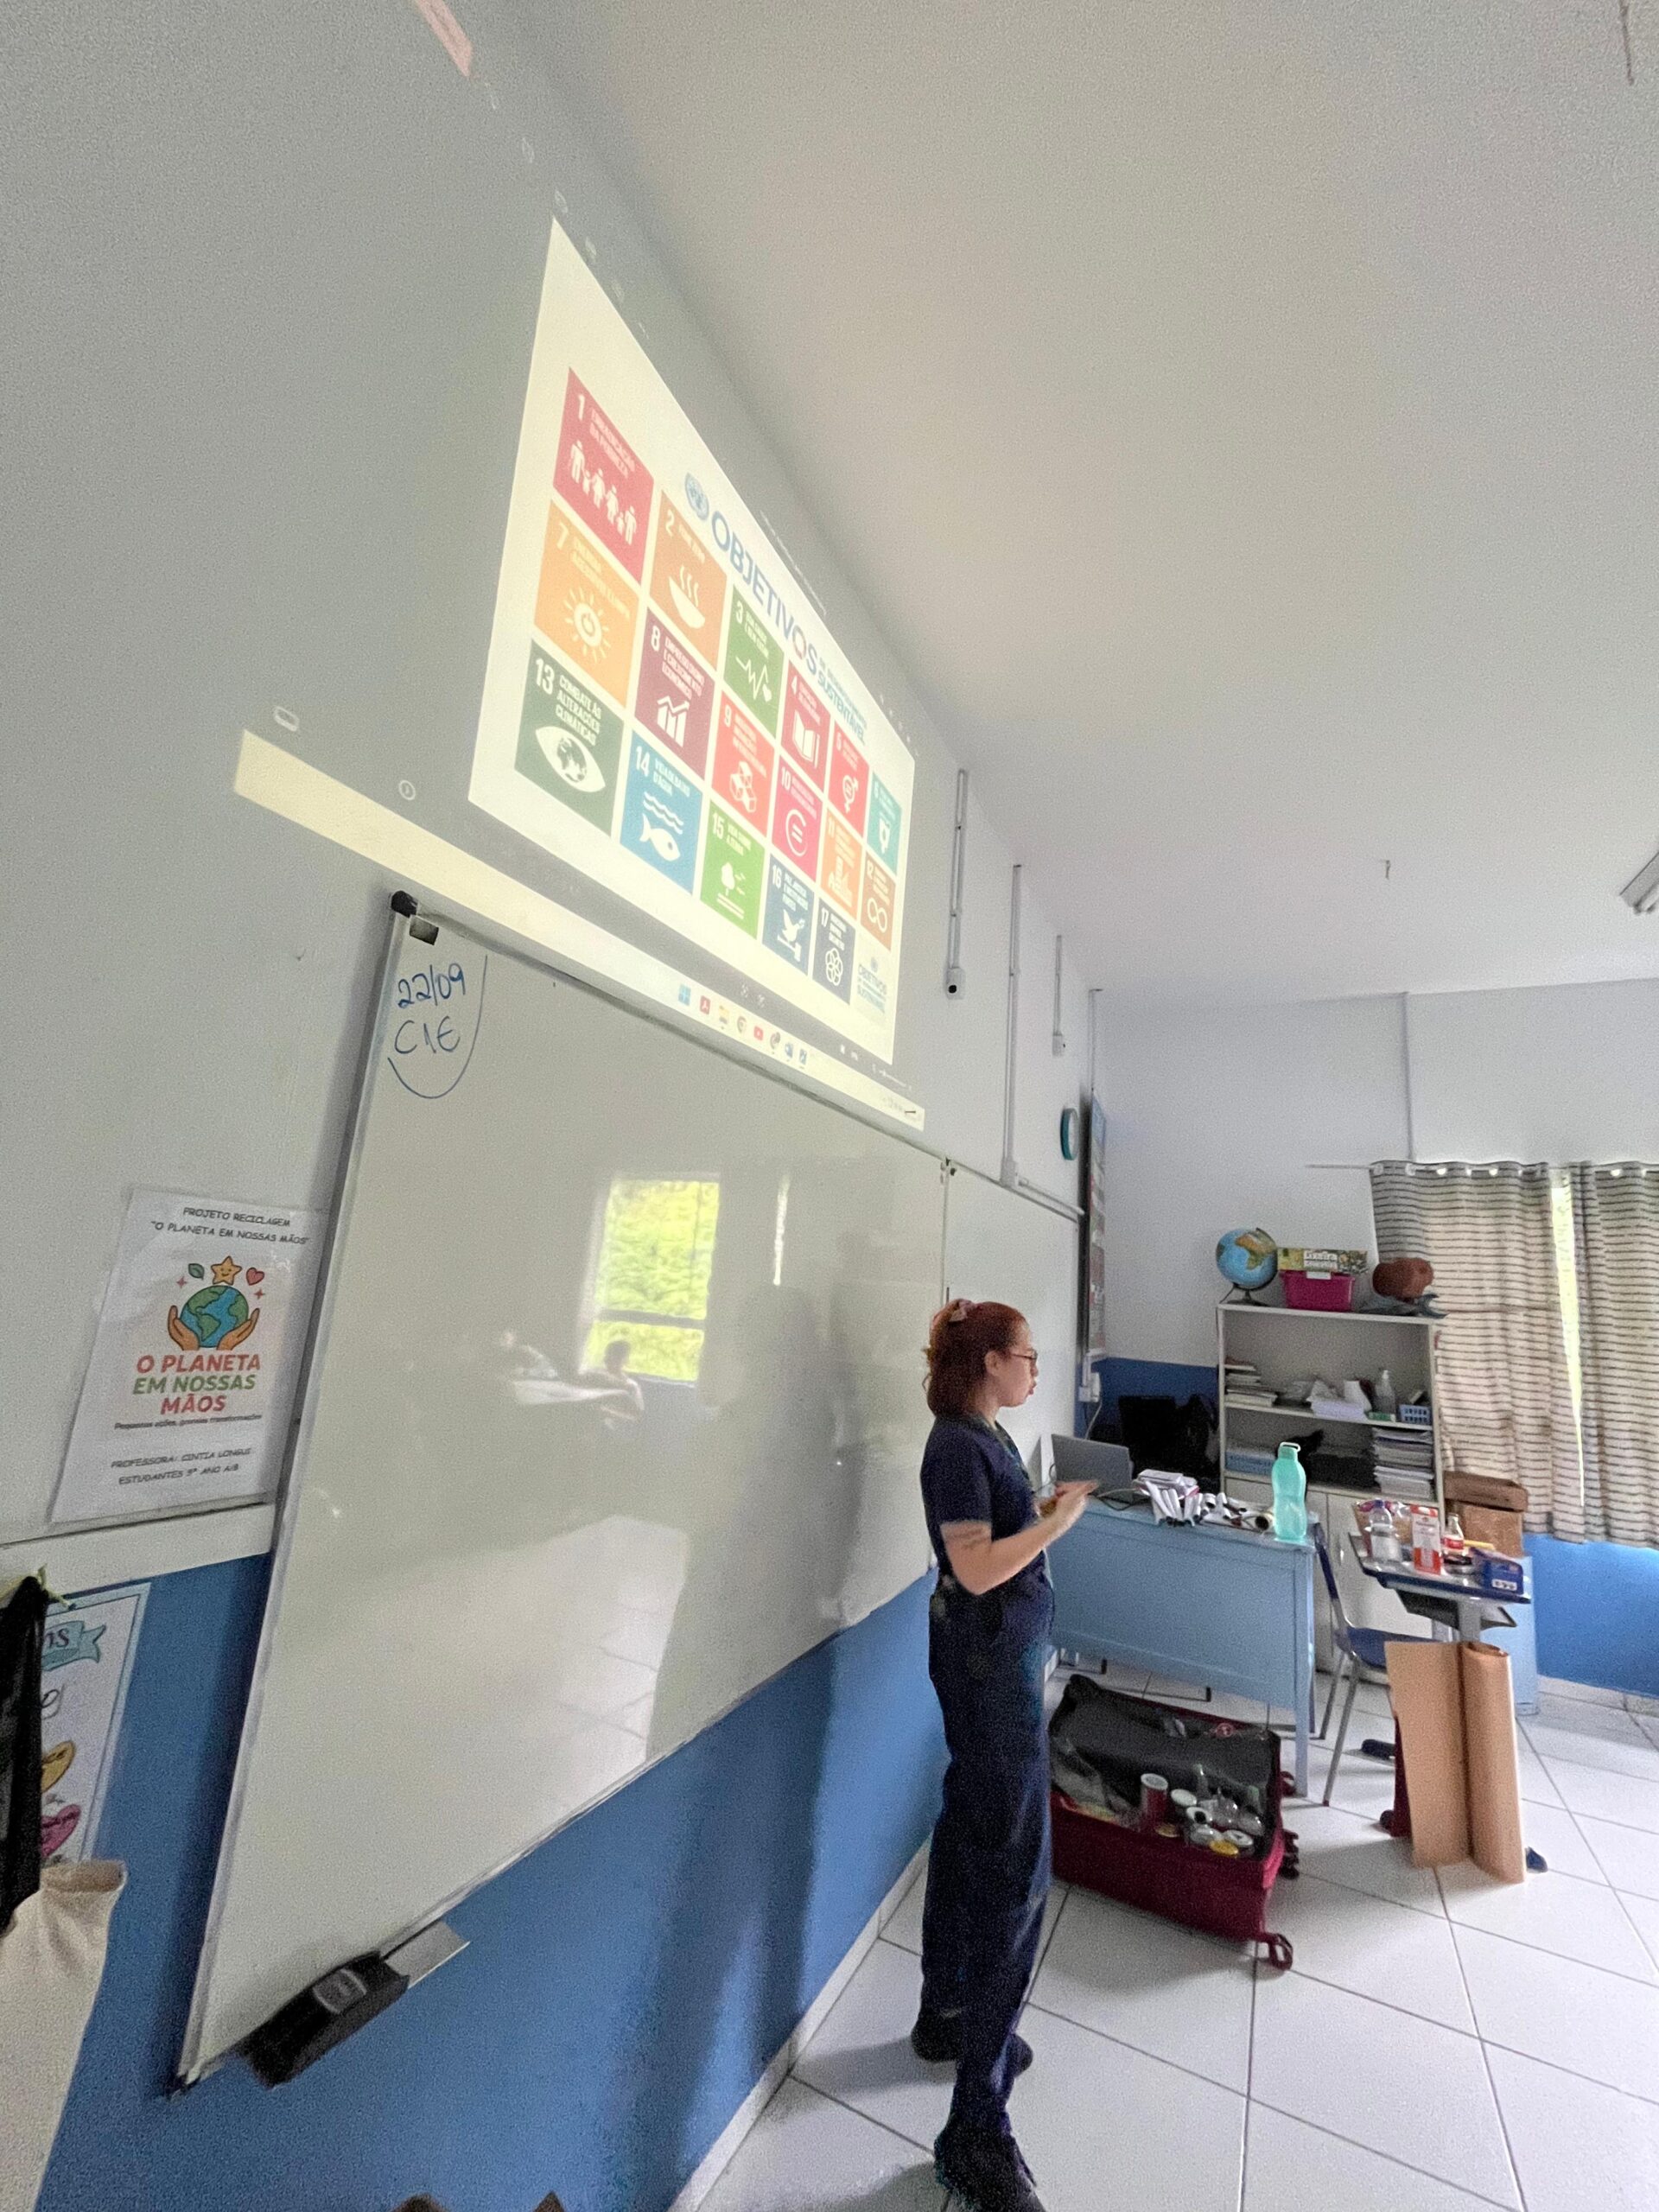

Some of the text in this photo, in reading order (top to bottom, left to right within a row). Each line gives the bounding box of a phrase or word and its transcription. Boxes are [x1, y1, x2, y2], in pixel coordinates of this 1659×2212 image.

[578, 394, 585, 421] 1
[665, 509, 675, 537] 2
[556, 522, 569, 550] 7
[712, 511, 817, 676] OBJETIVOS
[734, 600, 744, 624] 3
[651, 626, 660, 651] 8
[535, 658, 555, 695] 13
[791, 675, 798, 696] 4
[724, 705, 732, 728] 9
[635, 746, 650, 777] 14
[781, 767, 791, 791] 10
[712, 812, 724, 840] 15
[829, 820, 835, 838] 11
[772, 864, 782, 889] 16
[821, 907, 829, 929] 17
[397, 963, 467, 1008] 22/09
[183, 1207, 290, 1227] PROJETO RECICLAGEM
[168, 1223, 214, 1236] PLANETA
[219, 1228, 233, 1237] EM
[237, 1230, 276, 1243] NOSSAS
[137, 1354, 260, 1373] O PLANETA
[133, 1374, 256, 1395] EM NOSSAS
[160, 1392, 227, 1414] MÃOS
[118, 1470, 183, 1484] ESTUDANTES
